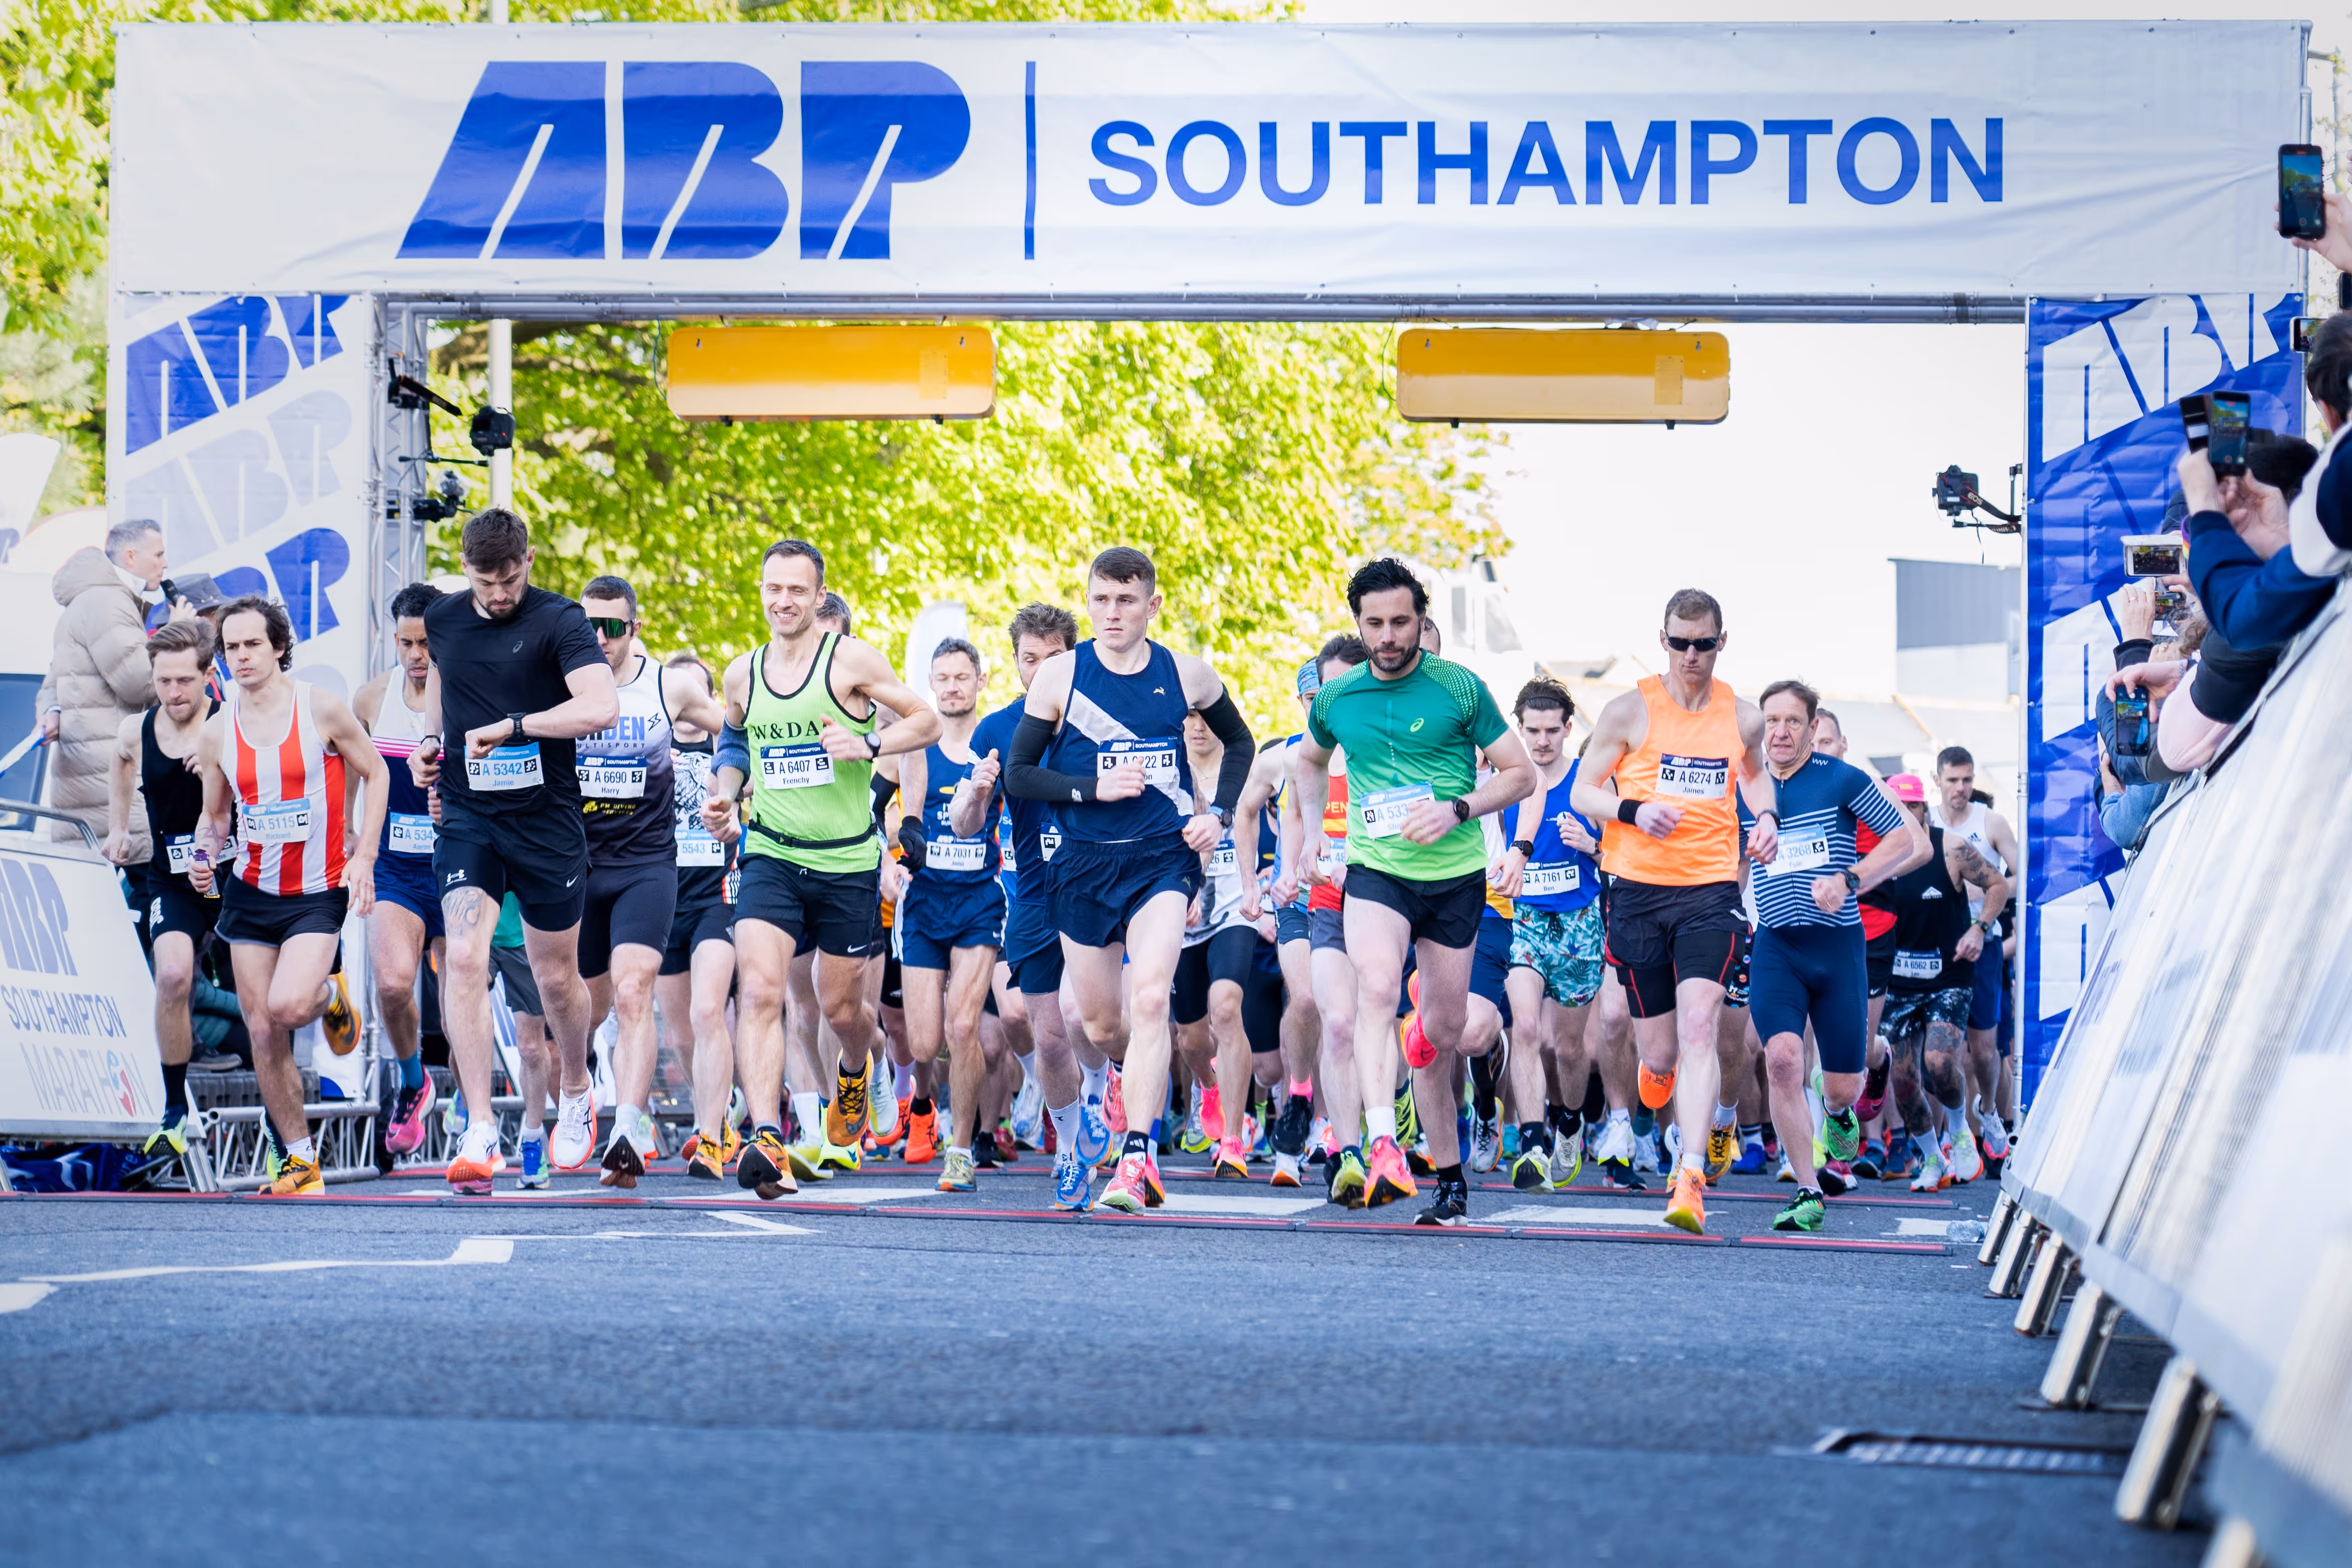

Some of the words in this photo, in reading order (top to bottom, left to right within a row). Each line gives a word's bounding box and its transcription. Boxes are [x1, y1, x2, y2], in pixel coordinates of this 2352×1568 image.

[396, 61, 971, 259] ABP
[1087, 117, 2004, 206] SOUTHAMPTON
[779, 762, 785, 774] A
[788, 760, 810, 774] 6407
[1133, 756, 1157, 768] 22
[483, 763, 490, 776] A
[493, 763, 523, 776] 5342
[595, 771, 601, 783] A
[604, 771, 627, 783] 6690
[783, 777, 809, 785] Frenchy
[1679, 771, 1685, 782] A
[1689, 772, 1711, 784] 6274
[601, 787, 620, 795] Harry
[1378, 808, 1385, 821] A
[1387, 803, 1410, 819] 533
[258, 819, 266, 830] A
[268, 816, 295, 830] 5115
[405, 828, 411, 840] A
[415, 829, 436, 841] 534
[682, 843, 705, 854] 5543
[945, 847, 950, 857] A
[953, 848, 971, 859] 7031
[1779, 850, 1784, 861] A
[1786, 844, 1811, 859] 3268
[1535, 873, 1540, 883] A
[1542, 872, 1561, 883] 7161
[1905, 960, 1909, 969] A
[1910, 960, 1927, 970] 6562
[1, 984, 127, 1037] SOUTHAMPTON
